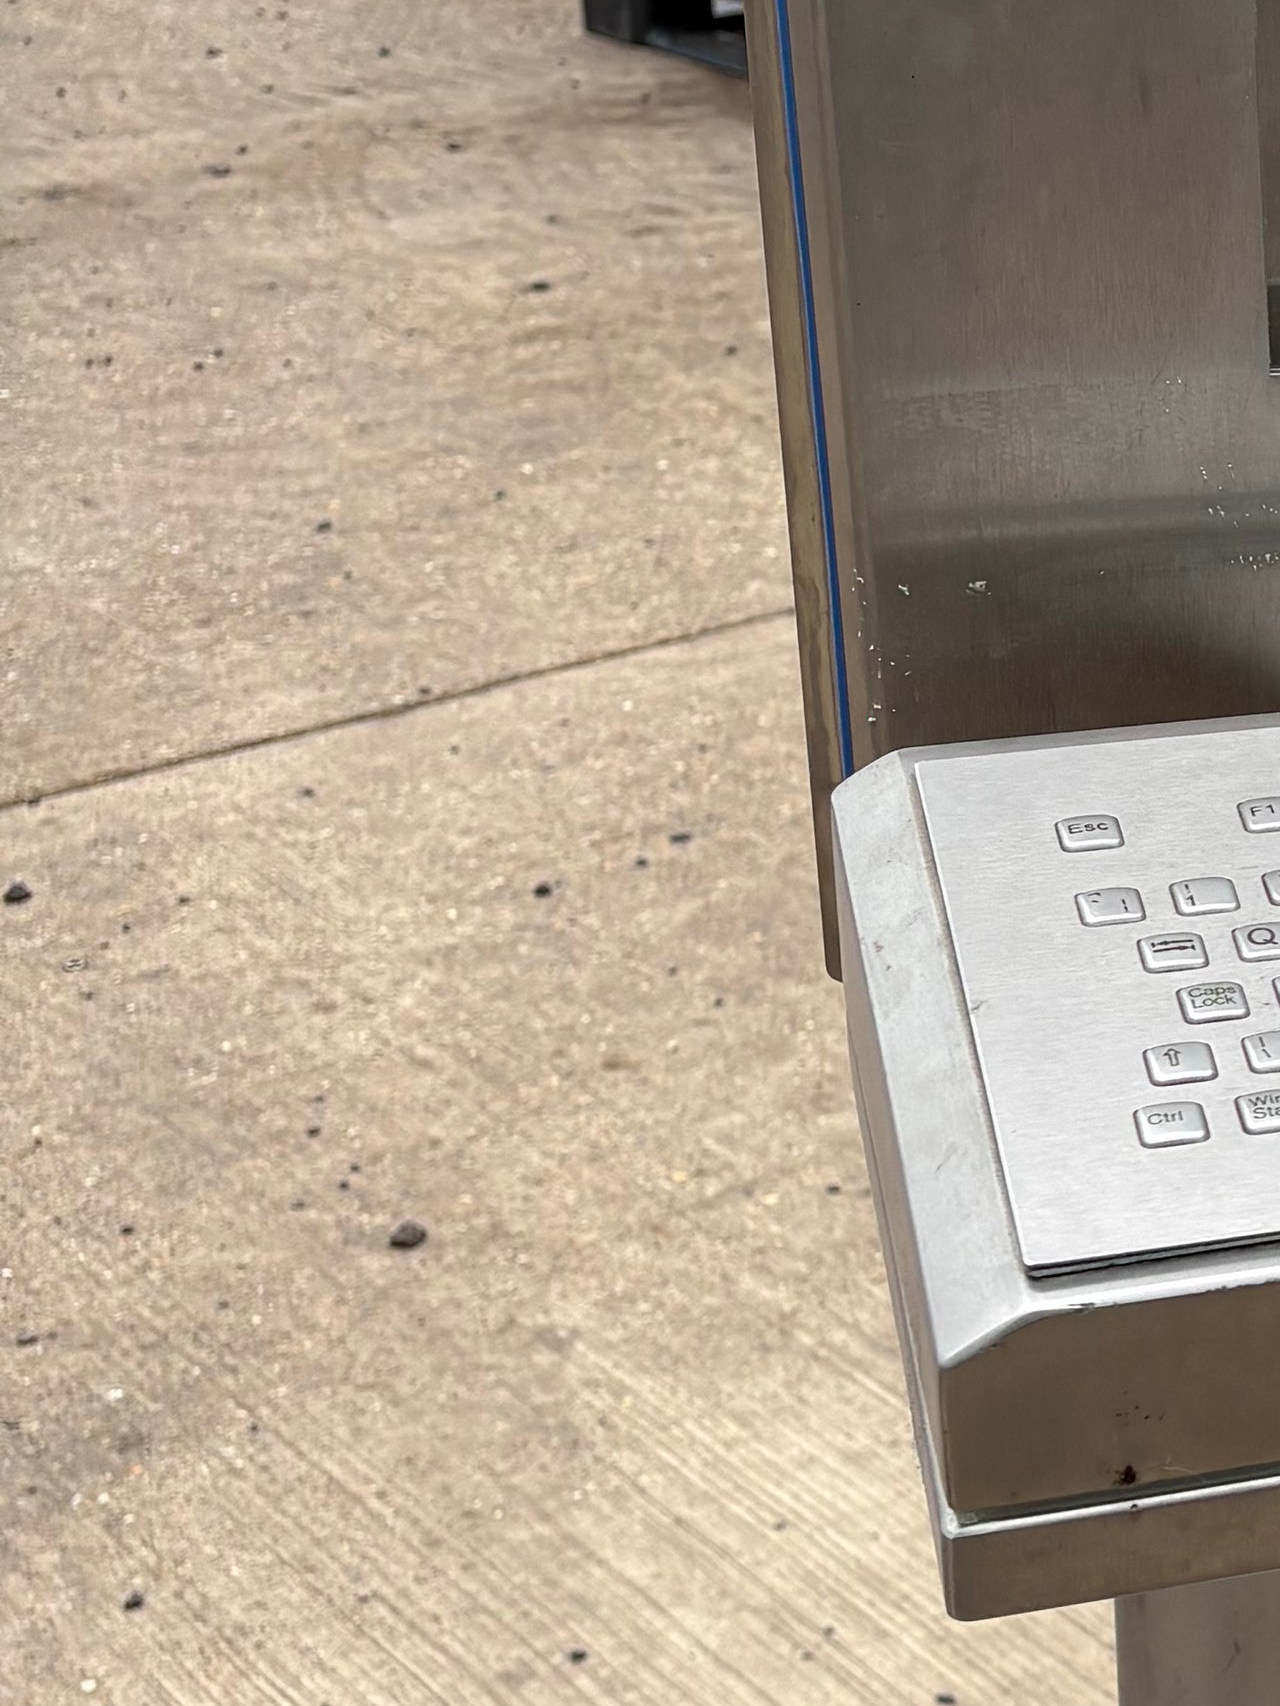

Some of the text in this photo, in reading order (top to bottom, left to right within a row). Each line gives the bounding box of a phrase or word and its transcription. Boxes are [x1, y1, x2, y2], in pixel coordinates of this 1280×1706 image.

[1250, 805, 1275, 817] F1
[1068, 822, 1109, 834] Esc
[1186, 896, 1196, 906] 1
[1248, 927, 1278, 945] Q
[1189, 985, 1236, 998] Caps
[1191, 995, 1236, 1009] Lock
[1147, 1110, 1184, 1125] Ctrl
